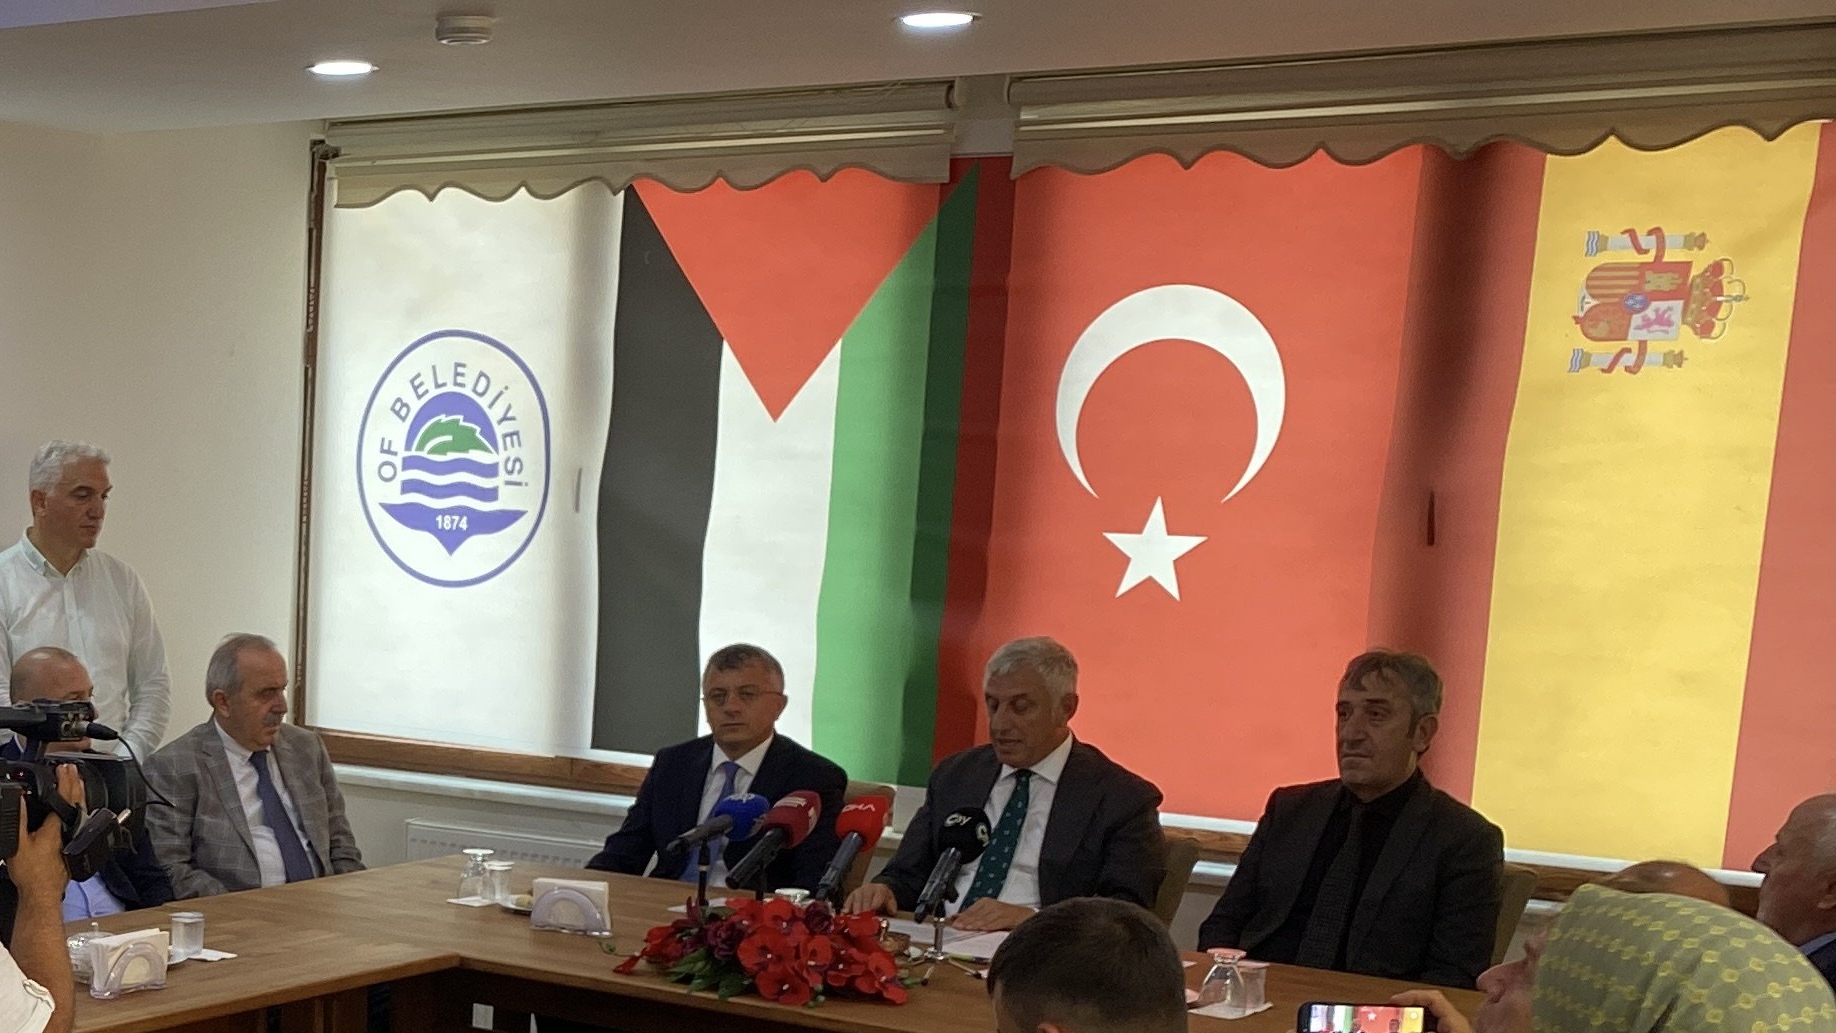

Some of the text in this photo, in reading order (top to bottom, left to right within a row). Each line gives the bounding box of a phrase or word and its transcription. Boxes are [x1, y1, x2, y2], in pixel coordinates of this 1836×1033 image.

[377, 362, 529, 487] OF BELEDİYESİ
[436, 514, 468, 531] 1874
